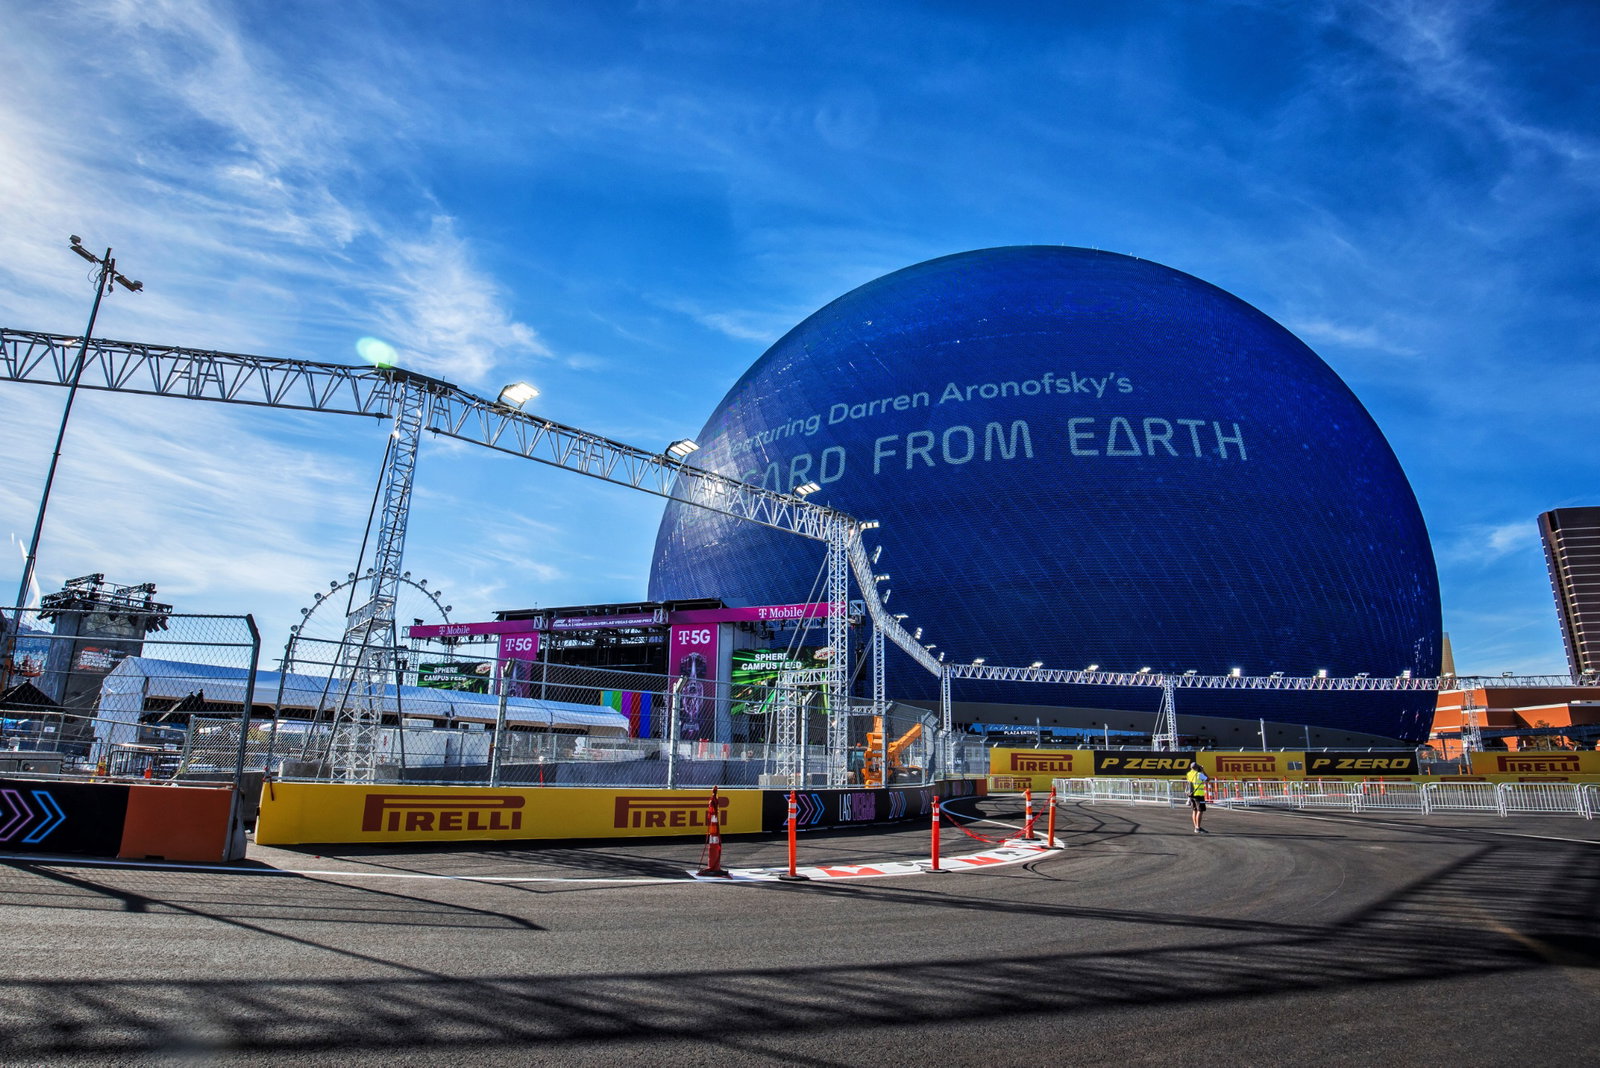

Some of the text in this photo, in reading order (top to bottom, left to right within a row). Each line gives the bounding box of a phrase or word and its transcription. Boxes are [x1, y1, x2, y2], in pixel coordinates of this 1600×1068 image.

[729, 371, 1133, 457] eaturing Darren Aronofsky's
[873, 420, 1034, 475] FROM
[1067, 416, 1248, 461] EARTH
[769, 607, 803, 618] Mobile
[446, 625, 470, 635] Mobile
[433, 666, 459, 674] SPHERE
[741, 662, 778, 671] CAMPUS
[423, 674, 449, 682] CAMPUS
[1010, 753, 1073, 772] PIRELLI
[1101, 757, 1191, 770] P ZERO
[1216, 755, 1276, 773] PIRELLI
[1312, 758, 1411, 770] P ZERO
[1497, 755, 1580, 772] PIRELLI
[362, 794, 526, 832] PIRELLI
[840, 793, 852, 822] LAS
